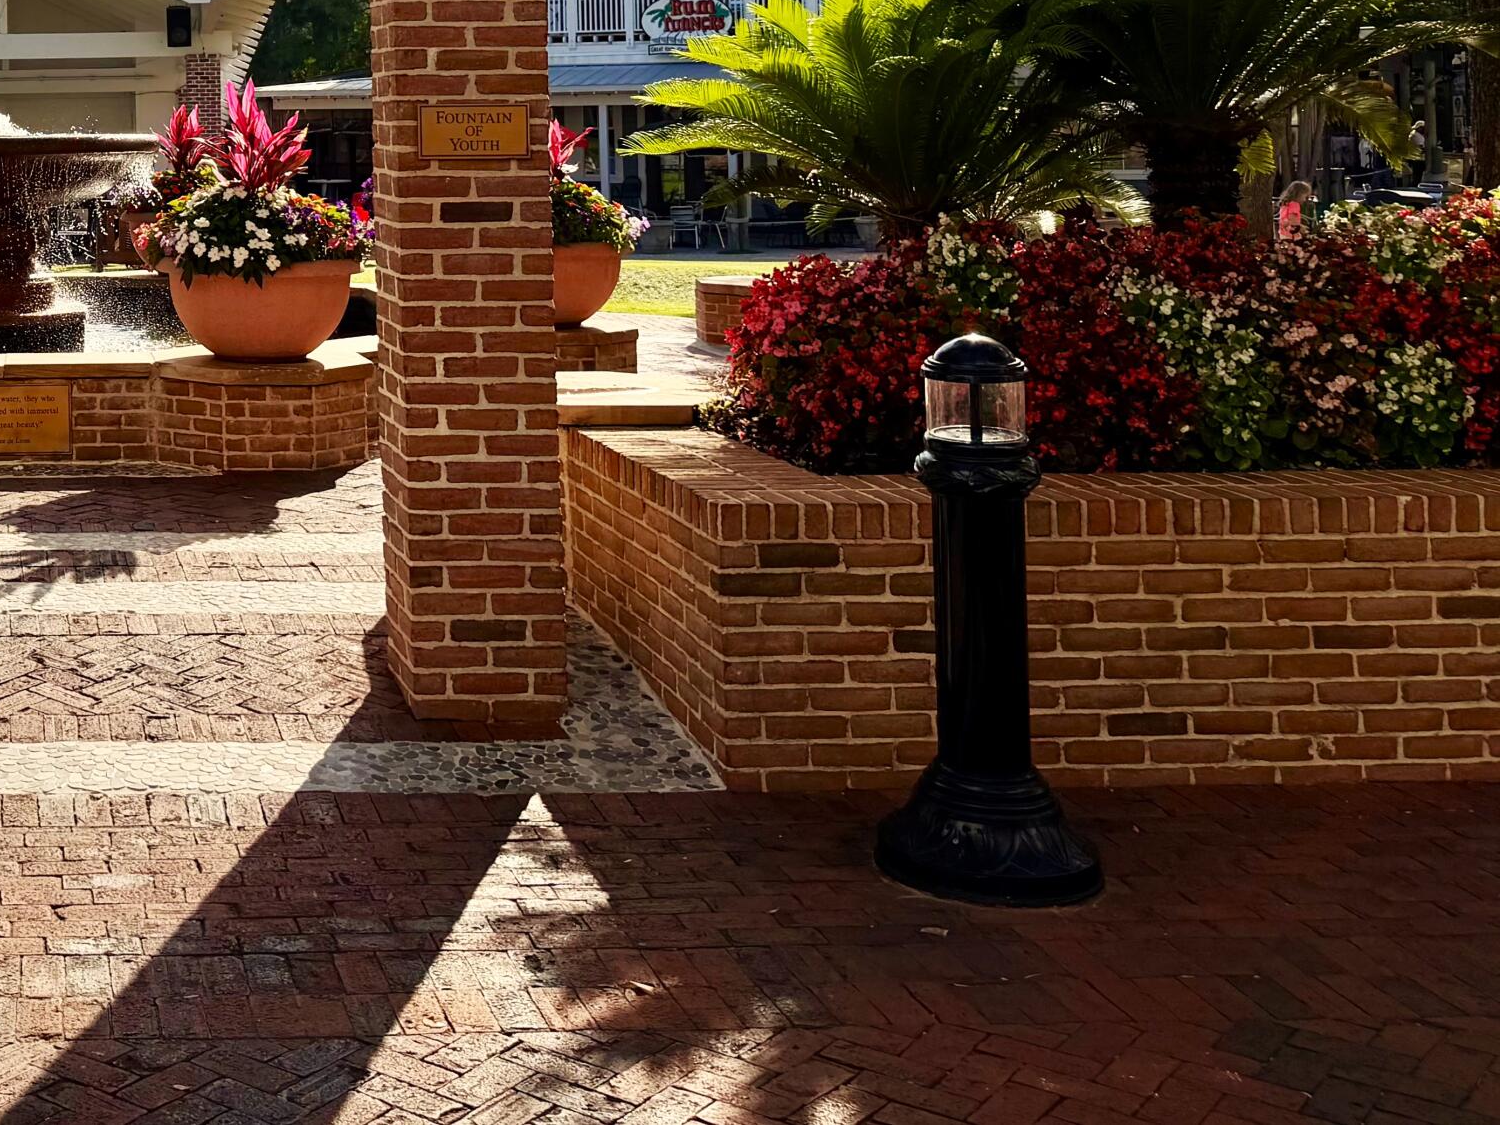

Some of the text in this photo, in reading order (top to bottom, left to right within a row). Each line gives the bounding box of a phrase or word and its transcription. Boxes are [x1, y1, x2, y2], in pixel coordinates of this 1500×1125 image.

[436, 110, 513, 124] FOUNTAIN
[465, 125, 484, 137] OF
[450, 138, 500, 151] YOUTH
